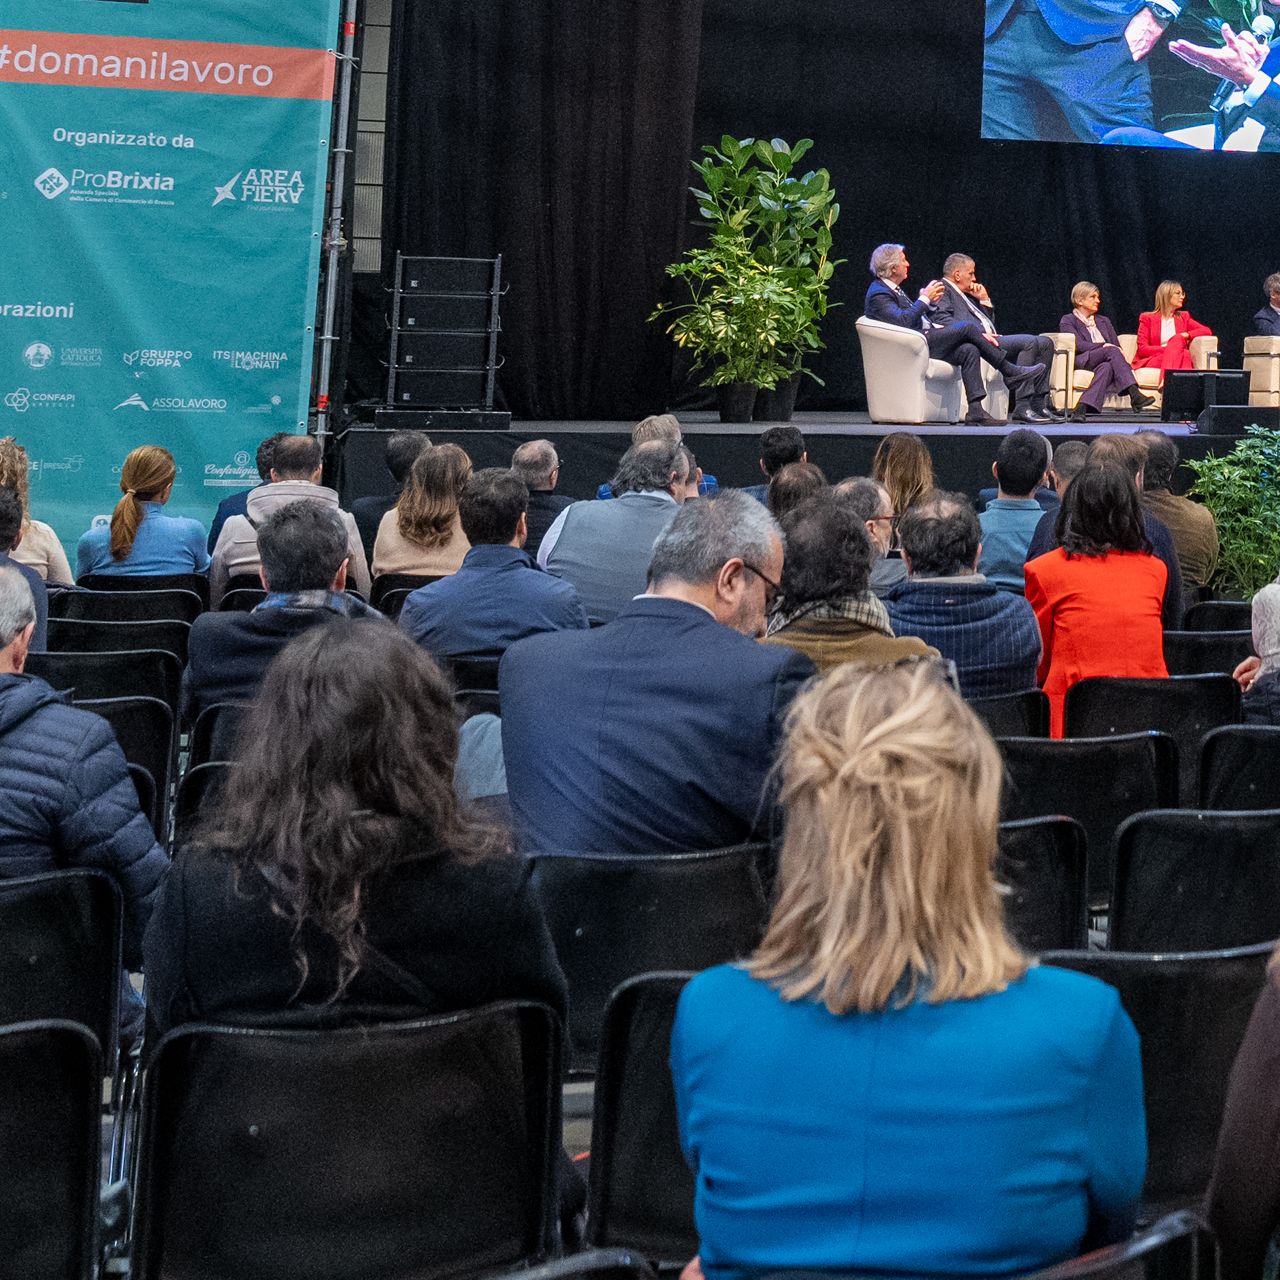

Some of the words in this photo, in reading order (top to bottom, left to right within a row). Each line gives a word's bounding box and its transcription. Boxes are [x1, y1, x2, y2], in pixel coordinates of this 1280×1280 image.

[53, 127, 168, 148] Organizzato
[172, 133, 194, 149] da
[71, 169, 175, 191] ProBrixia
[242, 168, 305, 187] AREA
[0, 301, 74, 318] razioni
[141, 349, 192, 360] GRUPPO
[213, 350, 230, 360] ITS
[235, 351, 288, 360] MACHINA
[140, 359, 182, 368] FOPPA
[32, 393, 75, 401] CONFAPI
[152, 398, 227, 409] ASSOLAVORO
